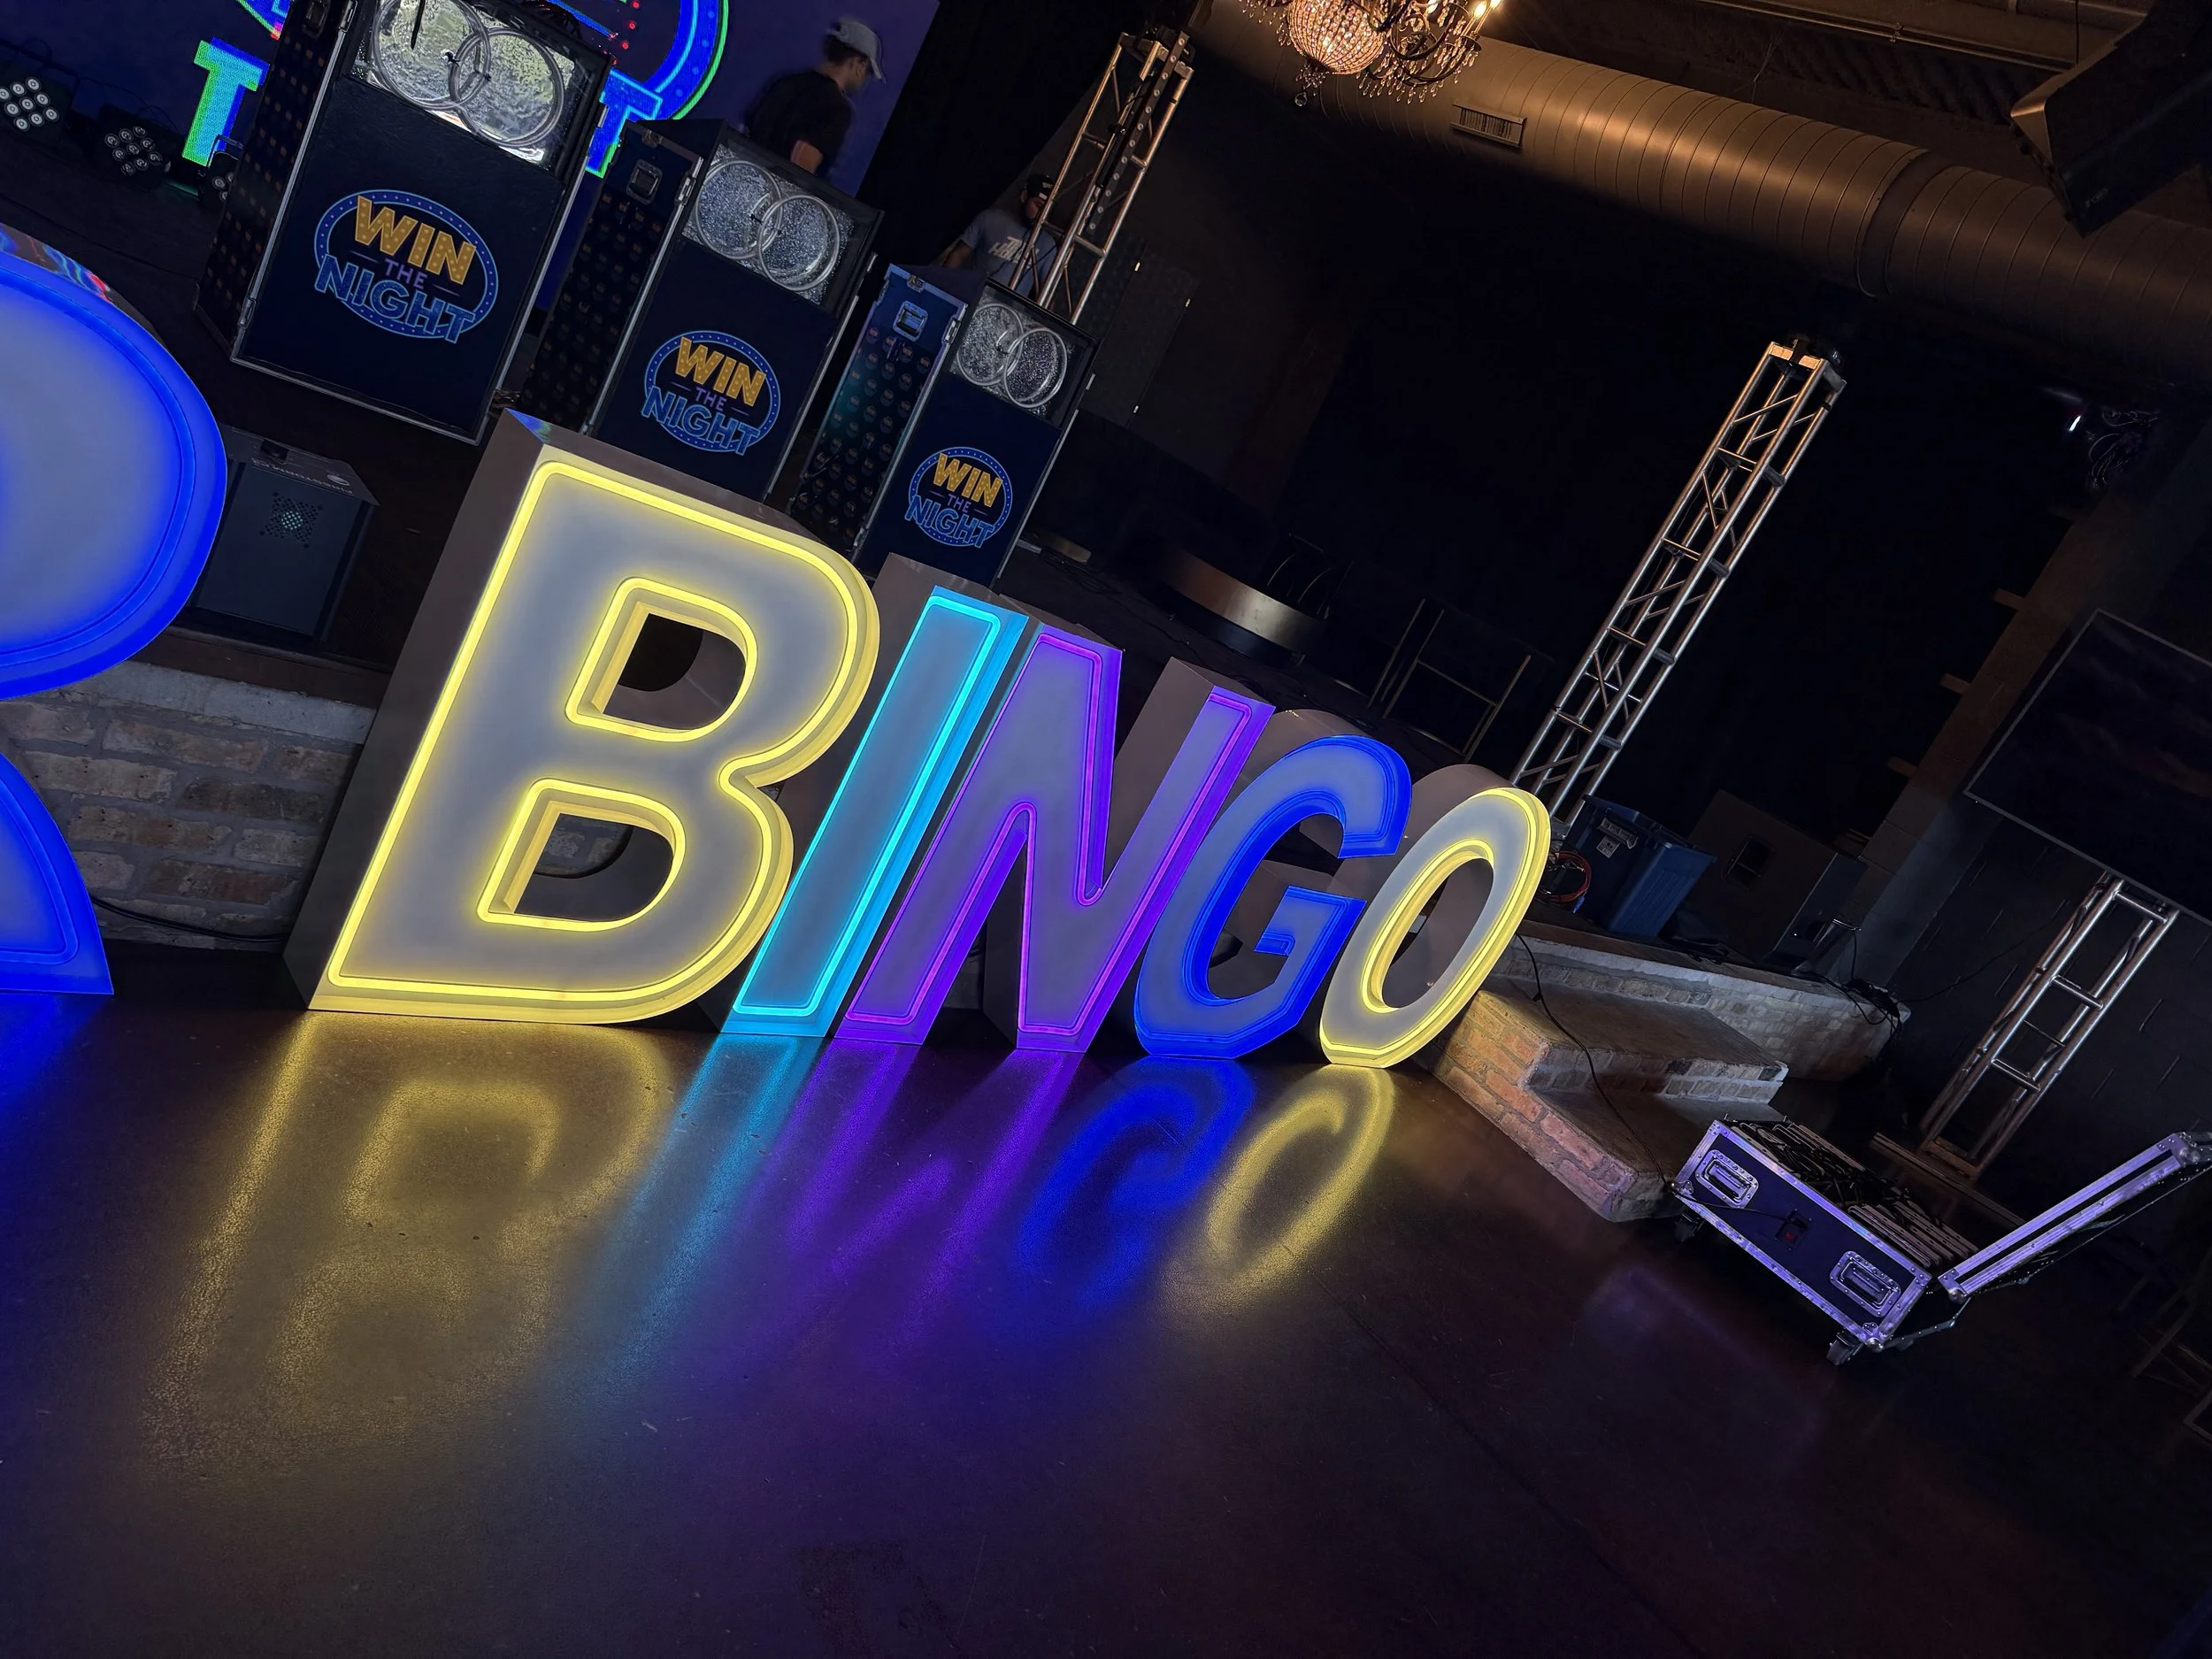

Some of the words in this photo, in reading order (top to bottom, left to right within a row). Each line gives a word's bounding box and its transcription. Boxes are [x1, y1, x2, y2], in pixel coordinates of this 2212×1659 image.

[355, 195, 477, 286] WIN
[313, 253, 476, 344] NIGHT
[384, 257, 428, 289] THE
[675, 336, 767, 407] WIN
[695, 387, 728, 412] THE
[641, 385, 761, 457] NIGHT
[933, 452, 1003, 508] WIN
[948, 494, 972, 513] THE
[904, 494, 995, 549] NIGHT
[305, 442, 1554, 1071] BINGO
